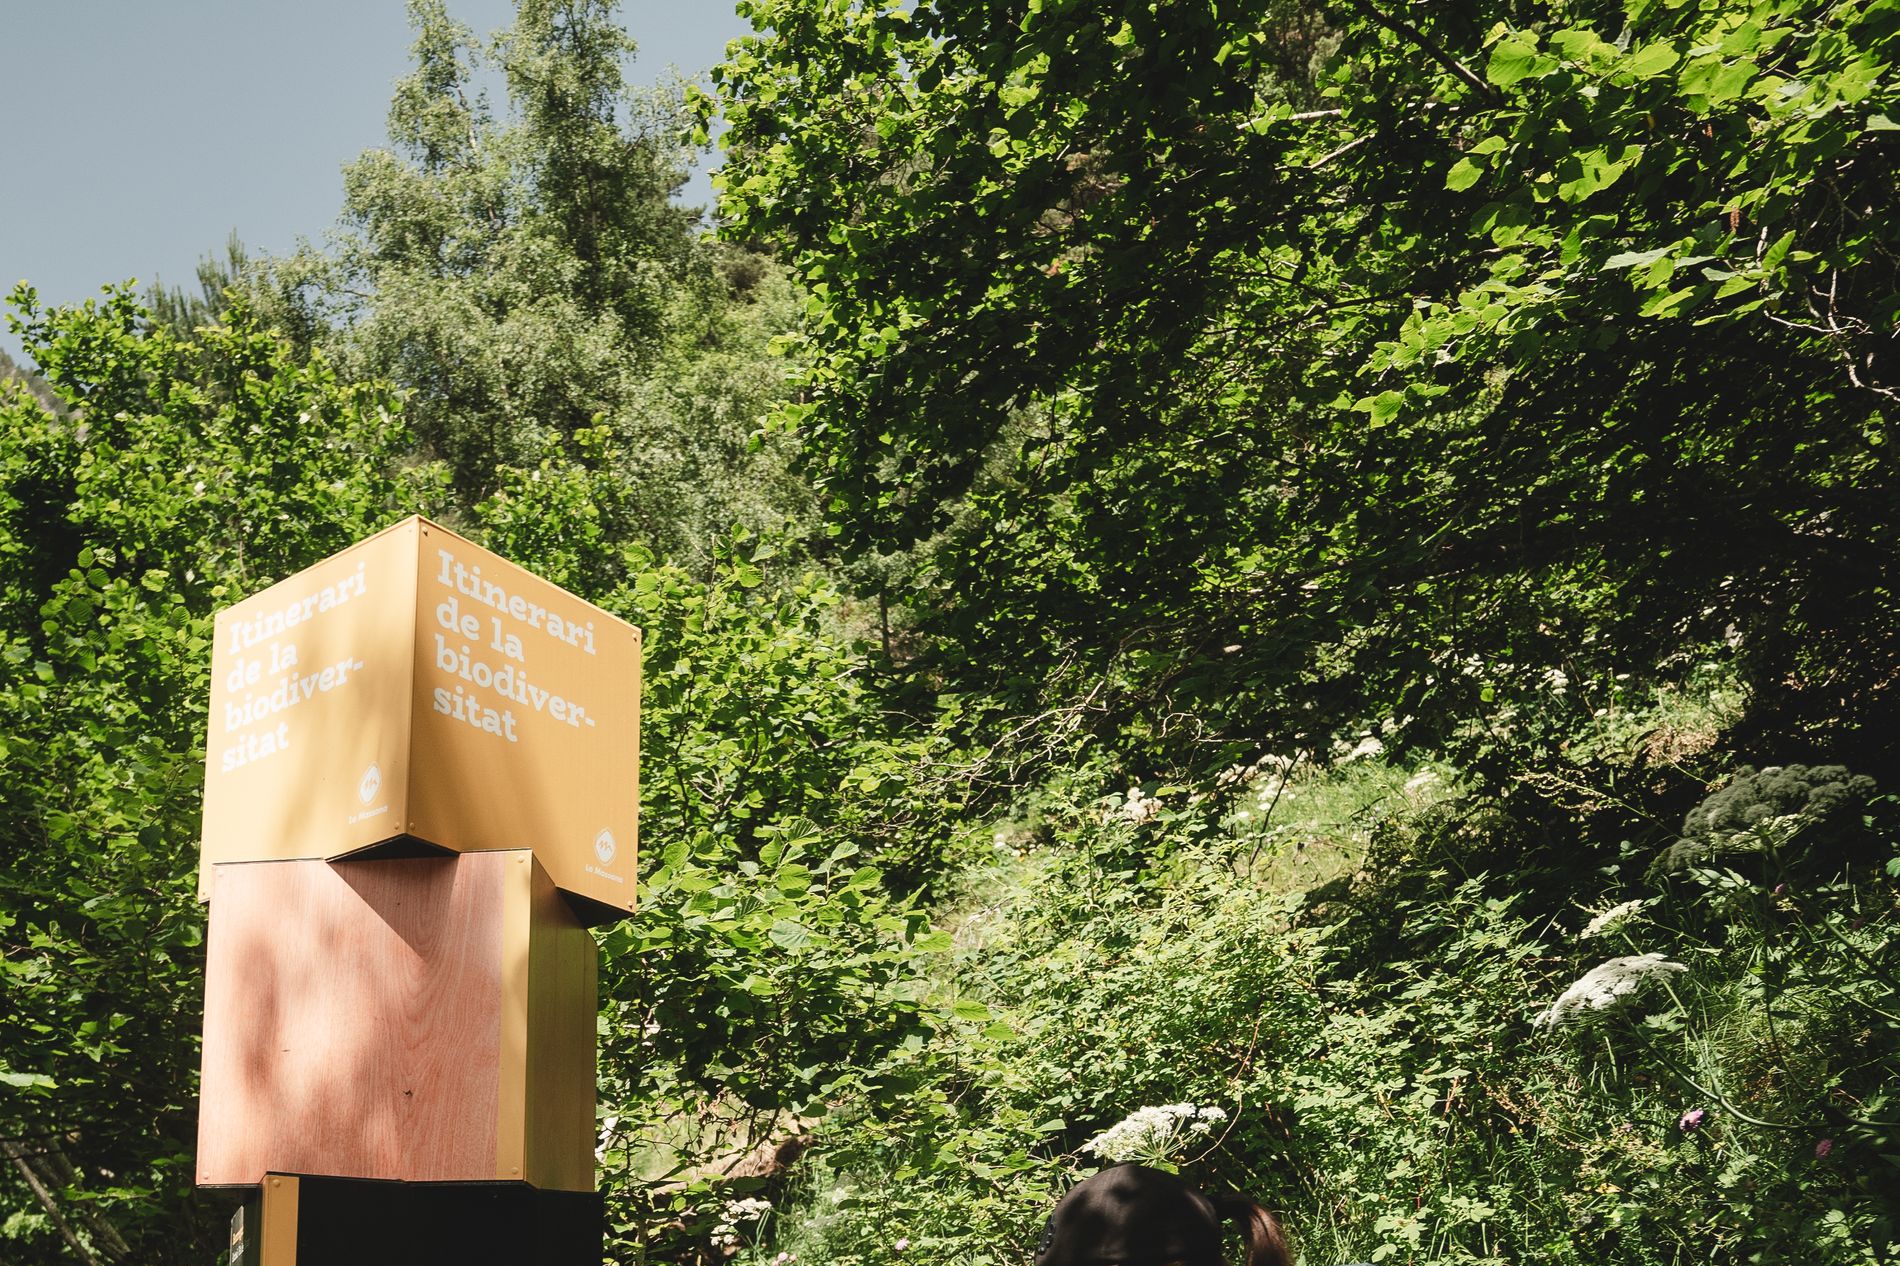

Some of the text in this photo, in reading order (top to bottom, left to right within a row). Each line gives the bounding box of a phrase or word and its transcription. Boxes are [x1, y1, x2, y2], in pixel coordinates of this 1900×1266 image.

[228, 560, 367, 656] Itinerari
[436, 596, 525, 662] de la
[438, 549, 596, 655] Itinerari
[225, 656, 364, 732] biodiver-
[226, 643, 298, 694] de la
[434, 632, 596, 728] biodiver-
[221, 721, 289, 773] sitat
[433, 685, 518, 743] sitat
